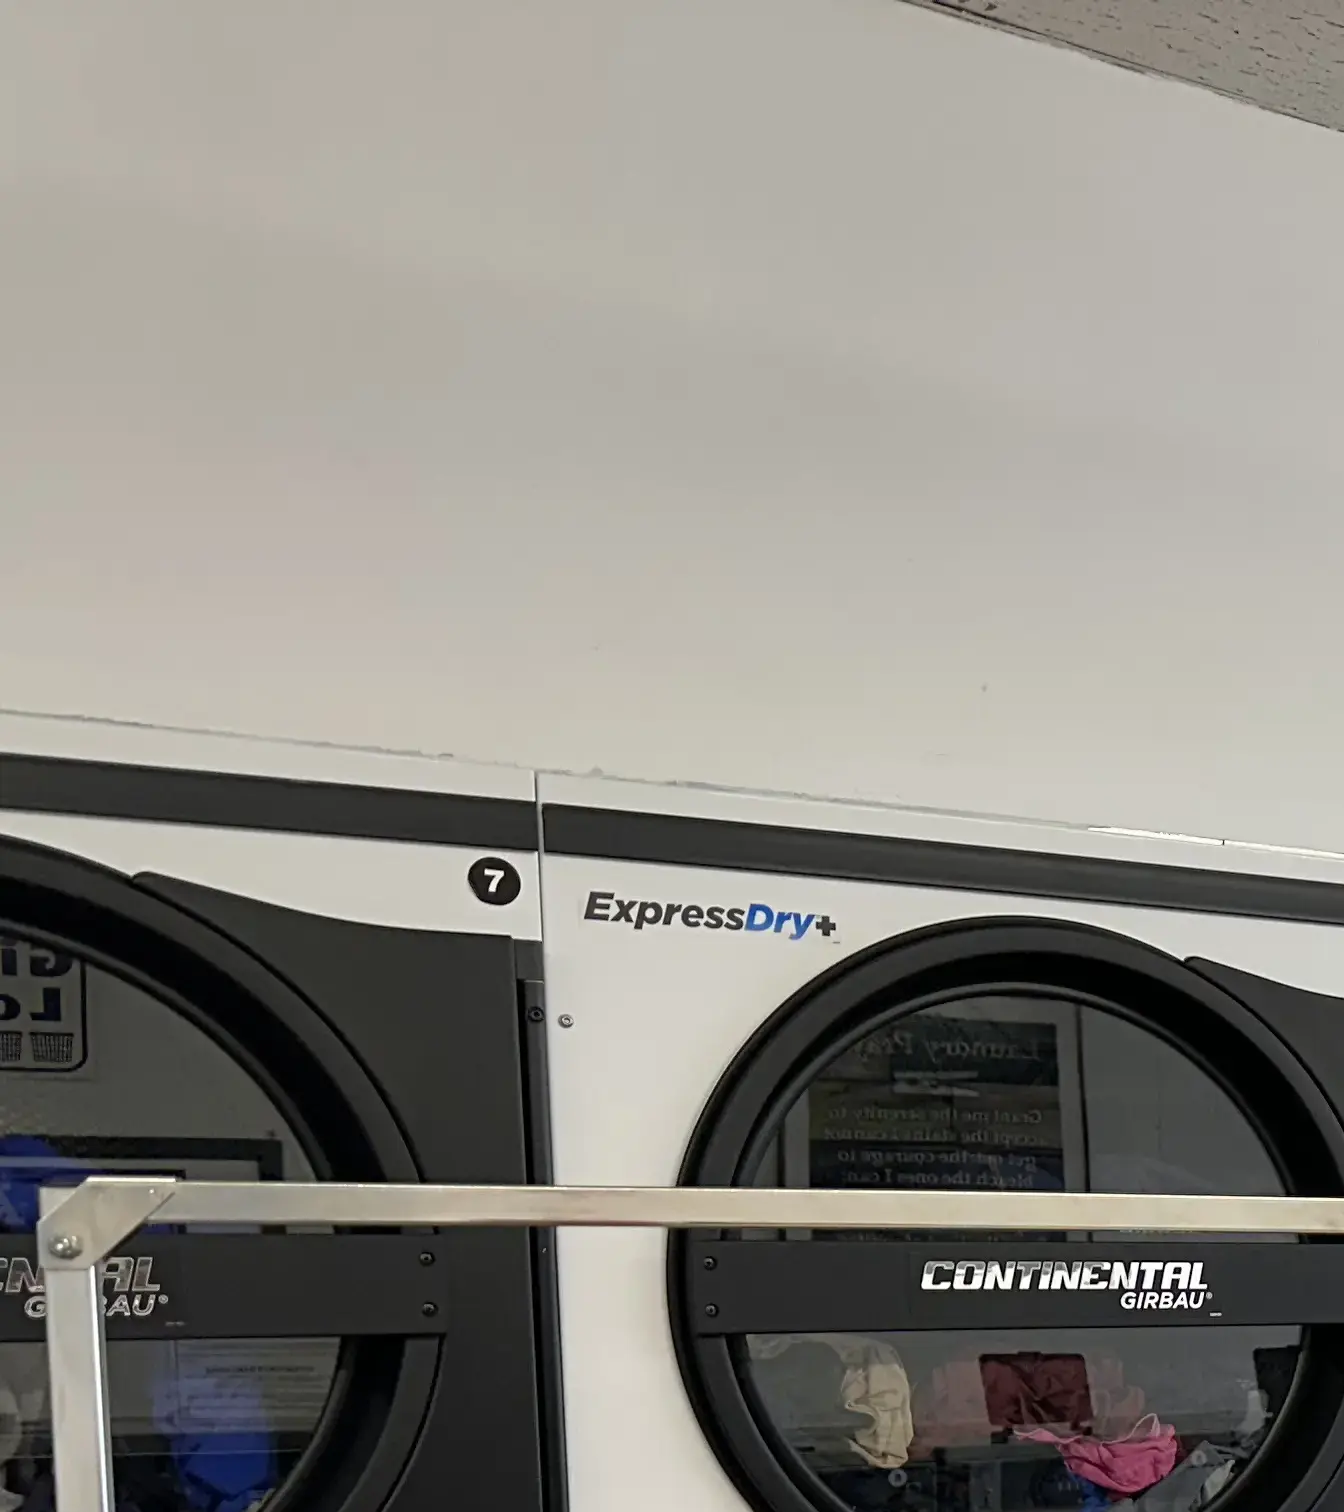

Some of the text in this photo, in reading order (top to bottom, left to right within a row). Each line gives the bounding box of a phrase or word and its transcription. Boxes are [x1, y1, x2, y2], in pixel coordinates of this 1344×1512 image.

[484, 868, 505, 894] 7
[584, 891, 837, 941] ExpressDry+
[921, 1261, 1208, 1291] CONTINENTAL
[1120, 1291, 1205, 1309] GIRBAU
